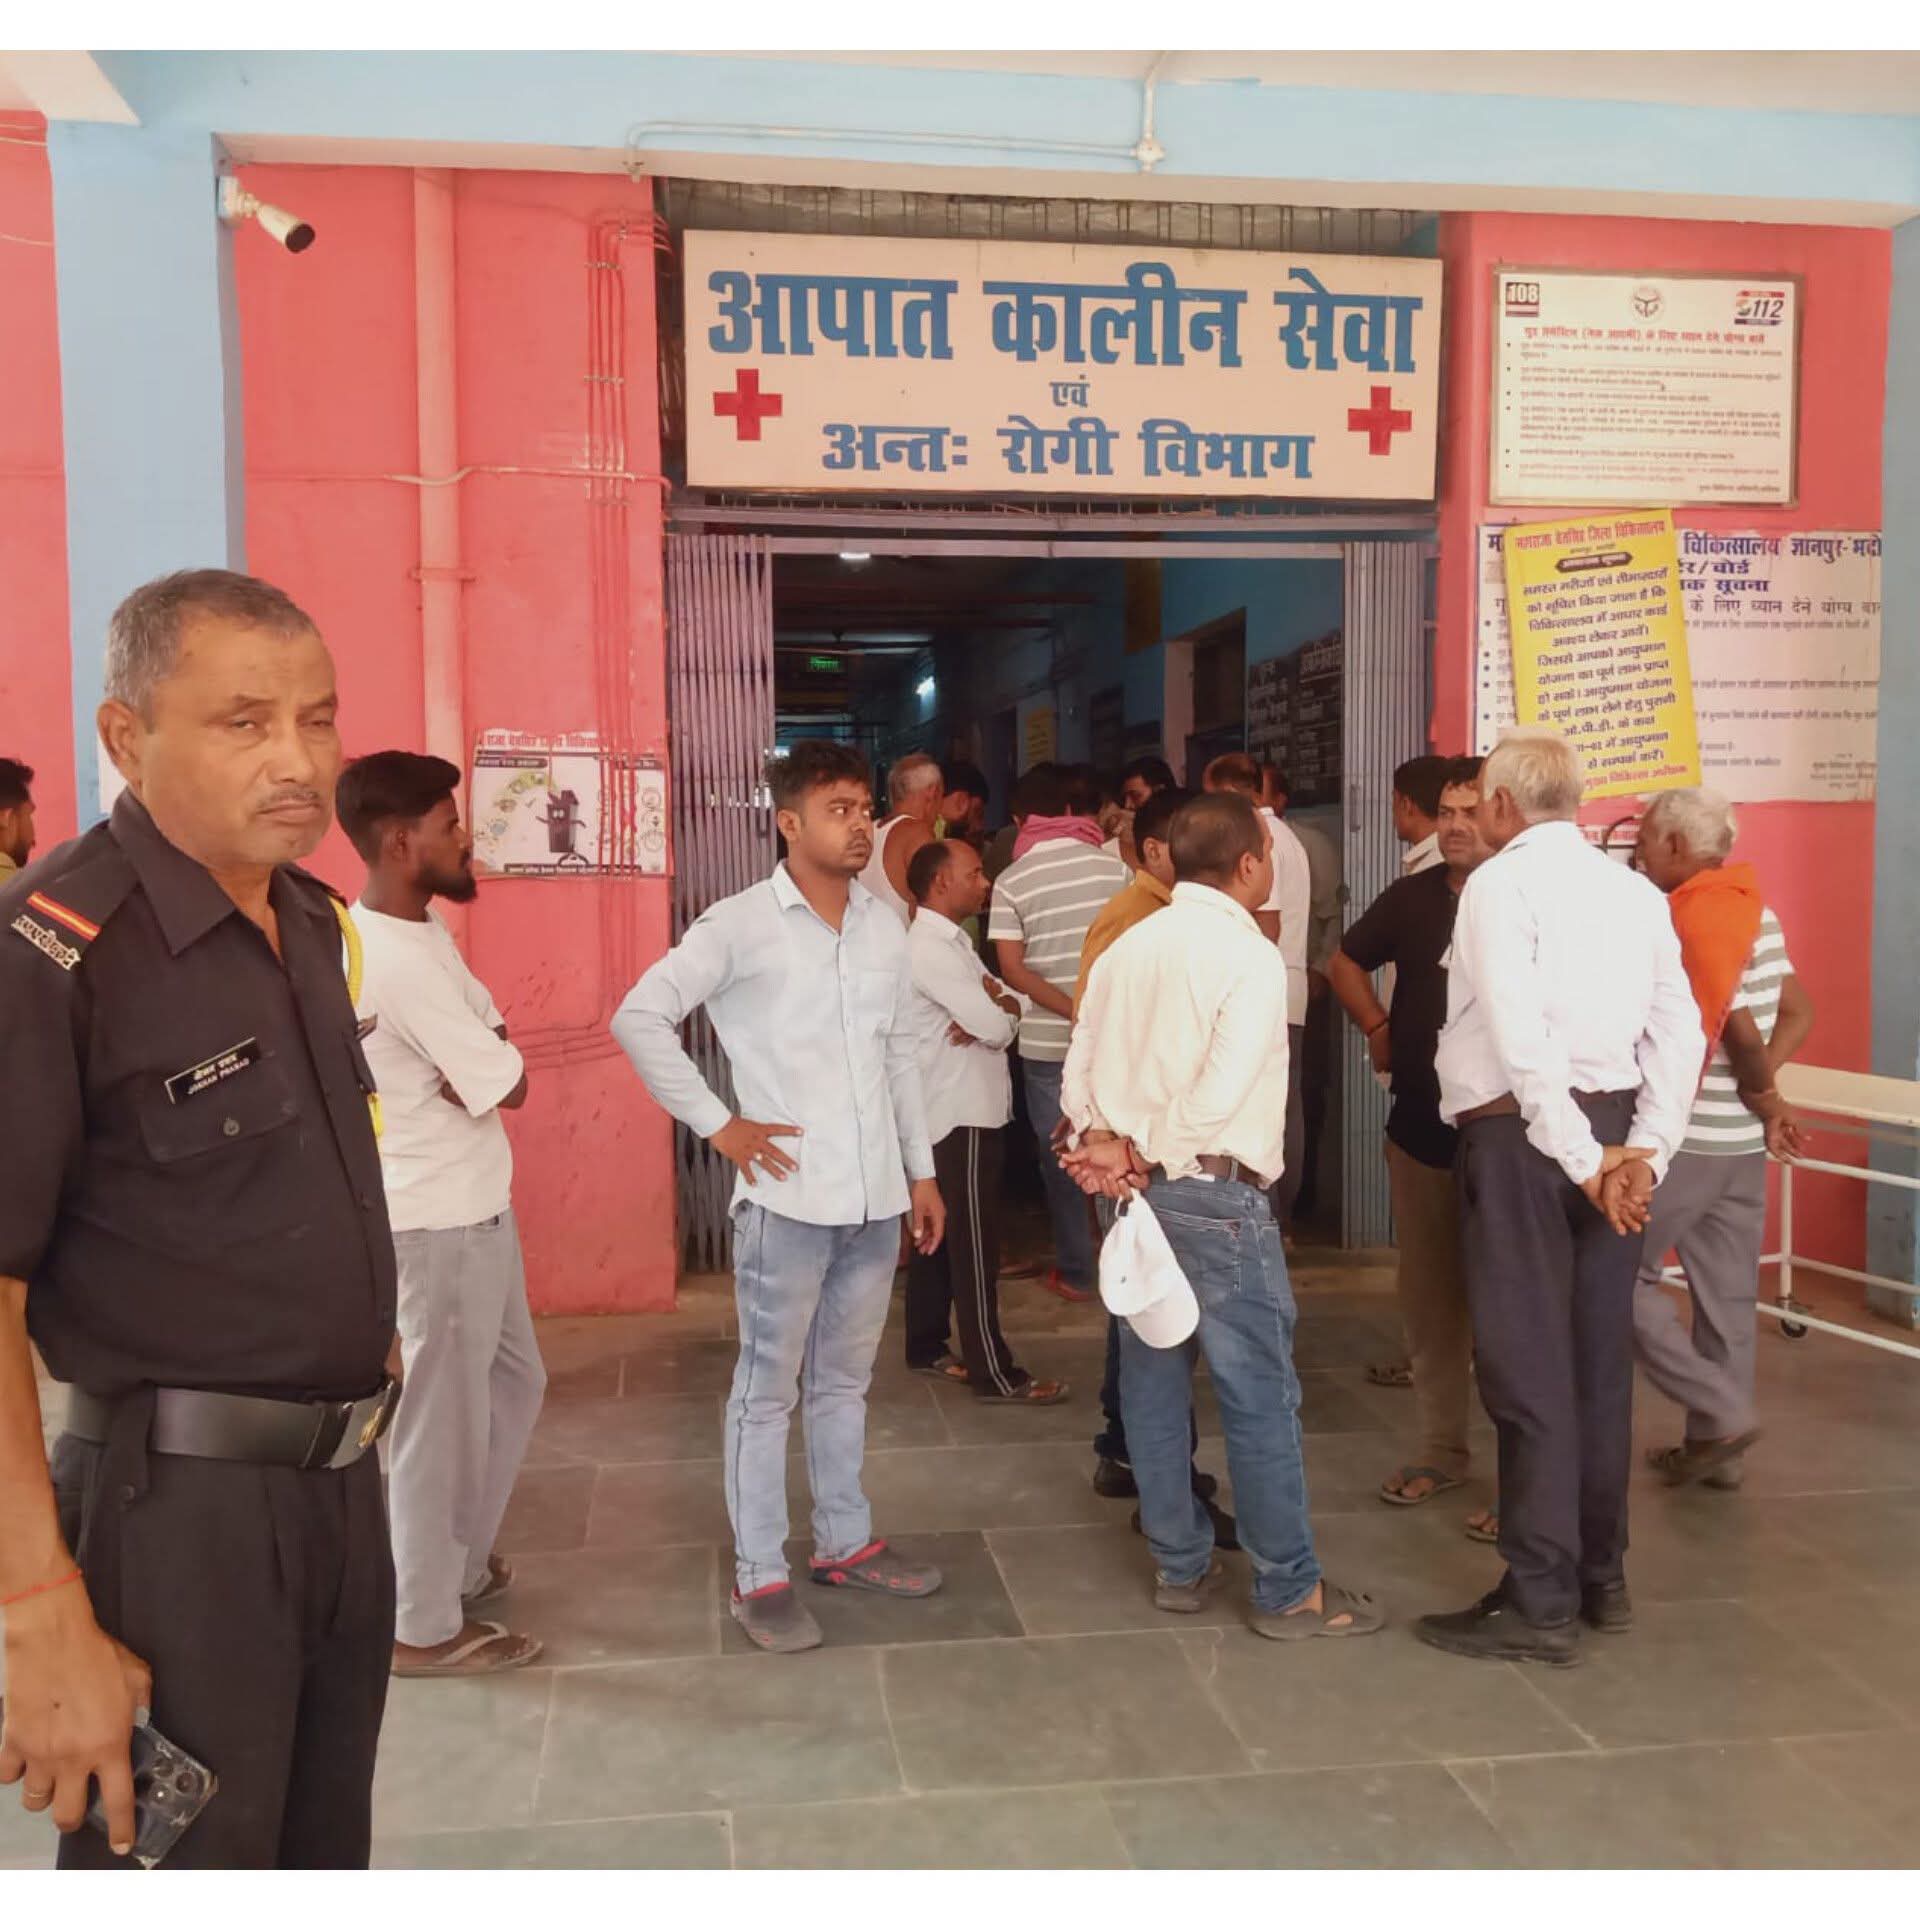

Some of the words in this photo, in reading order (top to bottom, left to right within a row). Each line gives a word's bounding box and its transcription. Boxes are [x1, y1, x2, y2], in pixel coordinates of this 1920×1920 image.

[1507, 283, 1538, 303] 108
[708, 270, 957, 360] आपात
[983, 262, 1247, 368] कालीन
[1274, 267, 1422, 373] सेवा
[1753, 299, 1784, 318] 112
[1050, 376, 1090, 408] एवं
[997, 416, 1119, 476] रोगी
[1139, 419, 1315, 478] विभाग
[1684, 531, 1780, 557] चिकित्सालय
[1714, 579, 1771, 594] सूचना
[1579, 594, 1607, 607] किया
[1714, 595, 1741, 616] लिए
[1751, 600, 1783, 614] ध्यान
[1792, 596, 1811, 614] देने
